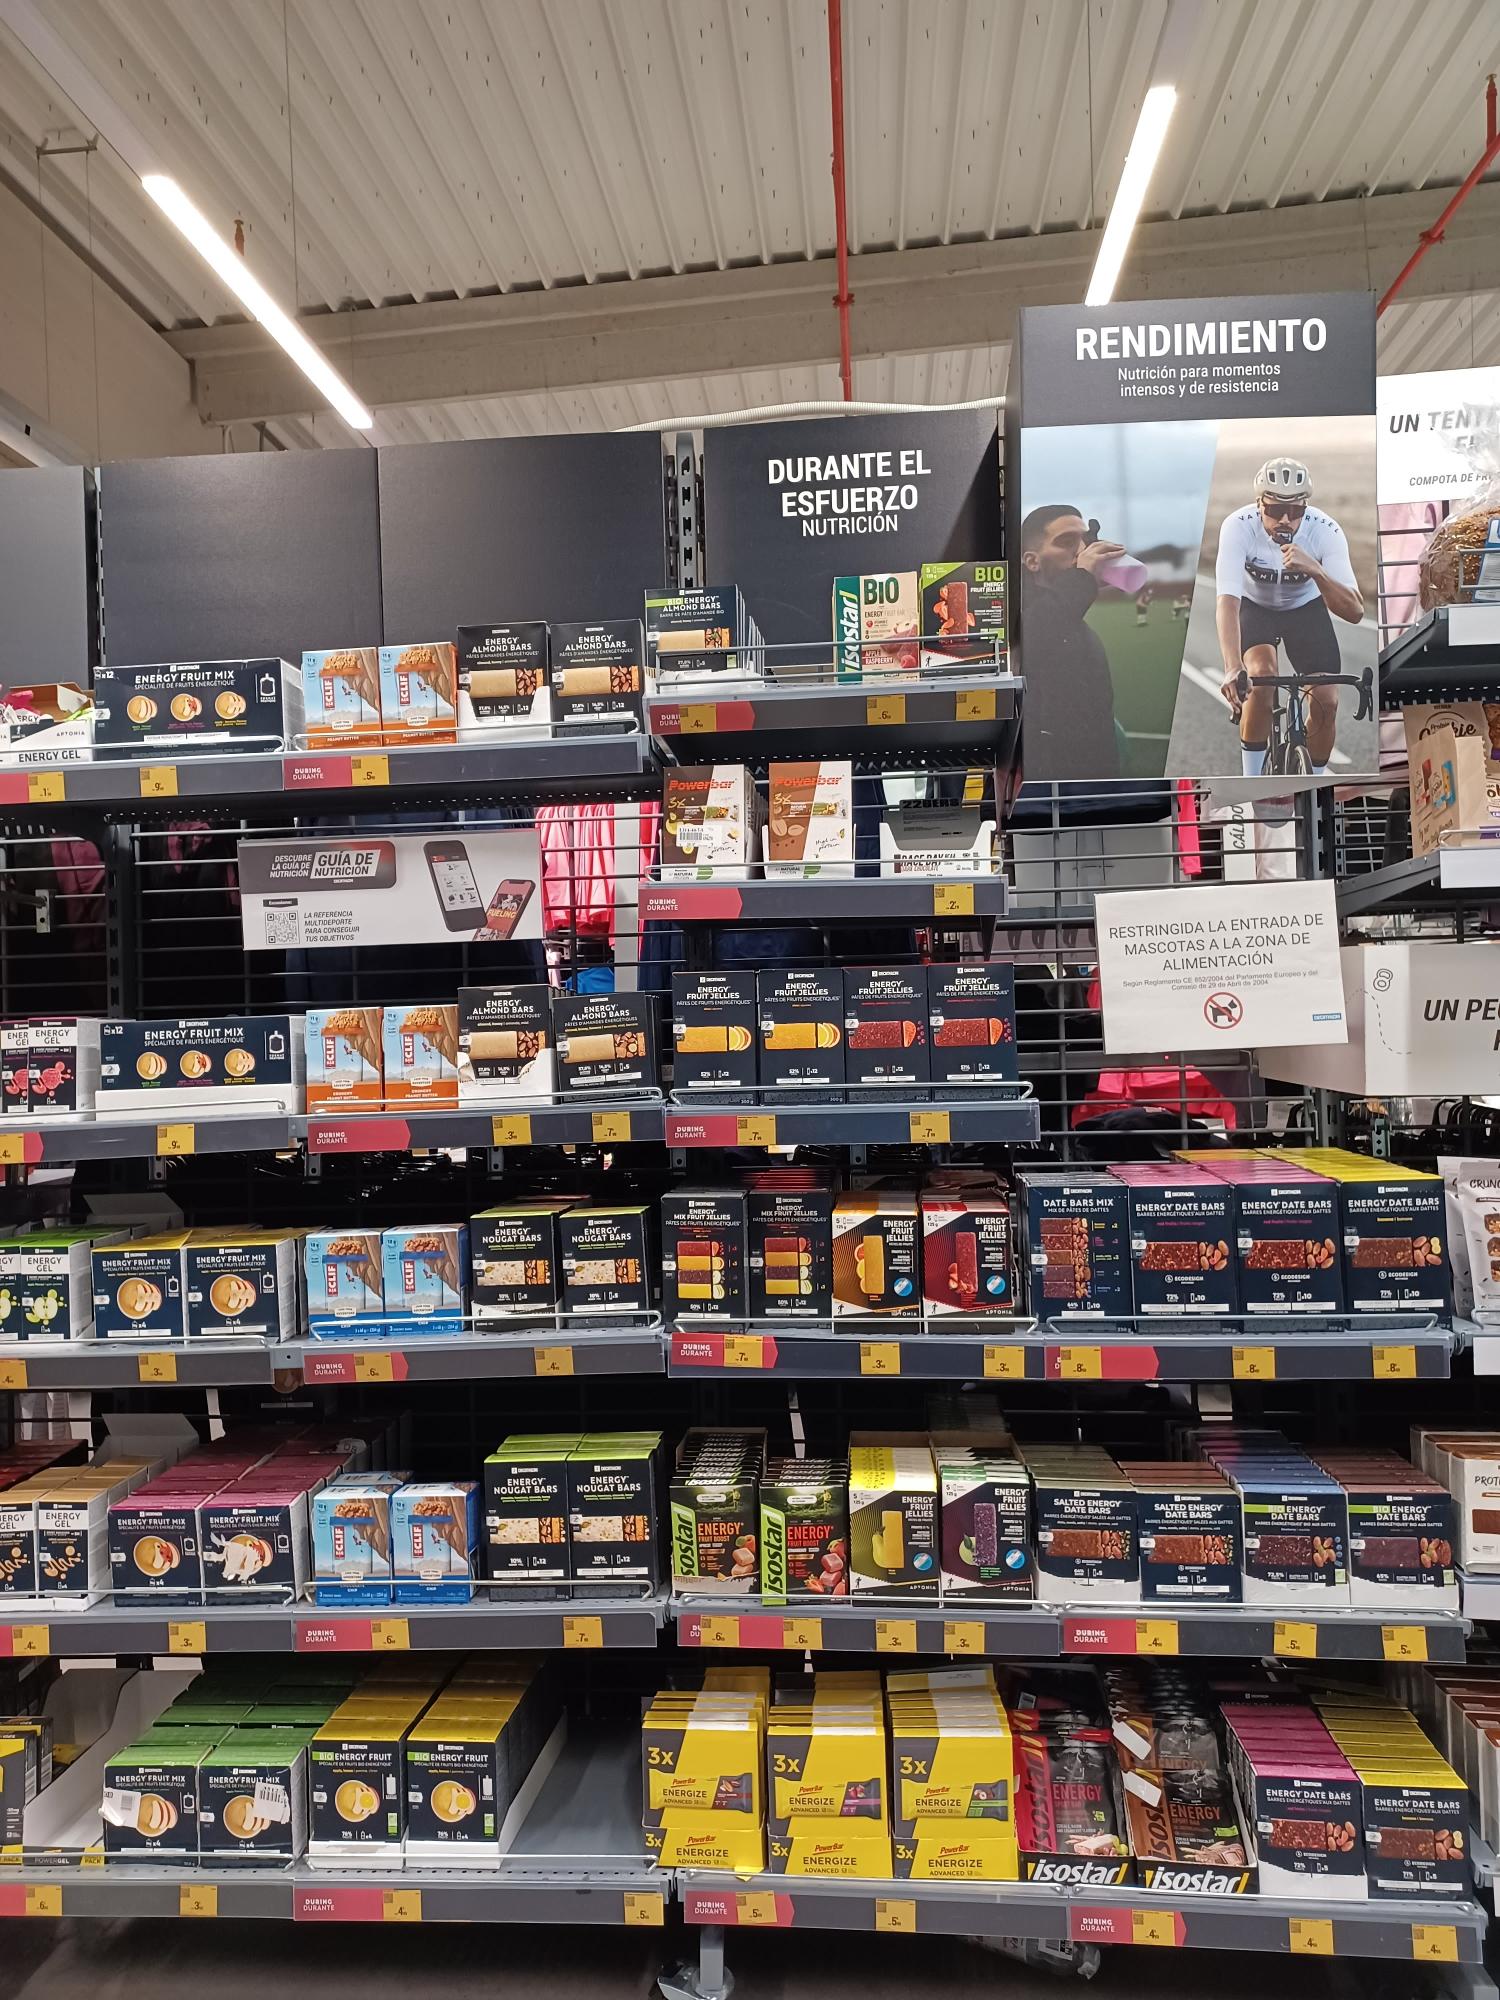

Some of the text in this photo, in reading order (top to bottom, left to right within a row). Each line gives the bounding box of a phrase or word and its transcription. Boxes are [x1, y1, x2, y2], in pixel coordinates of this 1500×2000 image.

[1075, 318, 1327, 361] RENDIMIENTO
[1118, 362, 1280, 381] Nutrición para momentos
[1120, 379, 1279, 397] intensos y de resistencia
[1390, 413, 1420, 433] UN
[768, 450, 931, 484] DURANTE EL
[1410, 474, 1457, 486] COMPOTA
[1461, 473, 1473, 482] DE
[782, 485, 918, 517] ESFUERZO
[802, 512, 898, 536] NUTRICIÓN
[975, 567, 1004, 582] BIO
[864, 576, 899, 605] BIO
[684, 596, 716, 604] ENERGY
[663, 604, 698, 612] ALMOND
[485, 637, 519, 645] ENERGY
[472, 643, 507, 652] ALMOND
[135, 670, 234, 684] ENERGY FRUIT MIX
[19, 750, 80, 762] ENERGY GEL
[275, 854, 312, 862] DESCUBRE
[318, 851, 373, 866] GUÍA DE
[282, 862, 299, 870] GUÍA
[270, 869, 309, 878] NUTRICIÓN
[487, 909, 517, 918] FUELING
[1109, 913, 1323, 939] RESTRINGIDA LA ENTRADA DE
[1124, 932, 1311, 956] MASCOTAS A LA ZONA DE
[1163, 952, 1274, 971] ALIMENTACIÓN
[486, 1000, 520, 1008] ENERGY
[473, 1007, 509, 1015] ALMOND
[1424, 999, 1500, 1021] UN PE
[145, 1028, 243, 1040] ENERGY FRUIT MIX
[1043, 1198, 1113, 1208] DATE BARS MIX
[1348, 1197, 1439, 1208] ENERGY DATE BARS
[495, 1228, 528, 1236] ENERGY
[886, 1233, 914, 1242] JELLIES
[196, 1254, 266, 1264] ENERGY FRUIT MIX
[1054, 1499, 1121, 1509] SALTED ENERGY
[1287, 1505, 1322, 1514] ENERGY
[1088, 1506, 1111, 1514] BARS
[787, 1526, 830, 1539] ENERGY
[764, 1516, 782, 1594] isostar
[1073, 1635, 1108, 1644] DURANTE
[335, 1753, 366, 1761] ENERGY
[369, 1753, 392, 1761] FRUIT
[648, 1748, 673, 1766] 3x
[662, 1788, 707, 1798] ENERGIZE
[803, 1856, 856, 1866] ENERGIZE
[1033, 1859, 1120, 1884] isostar
